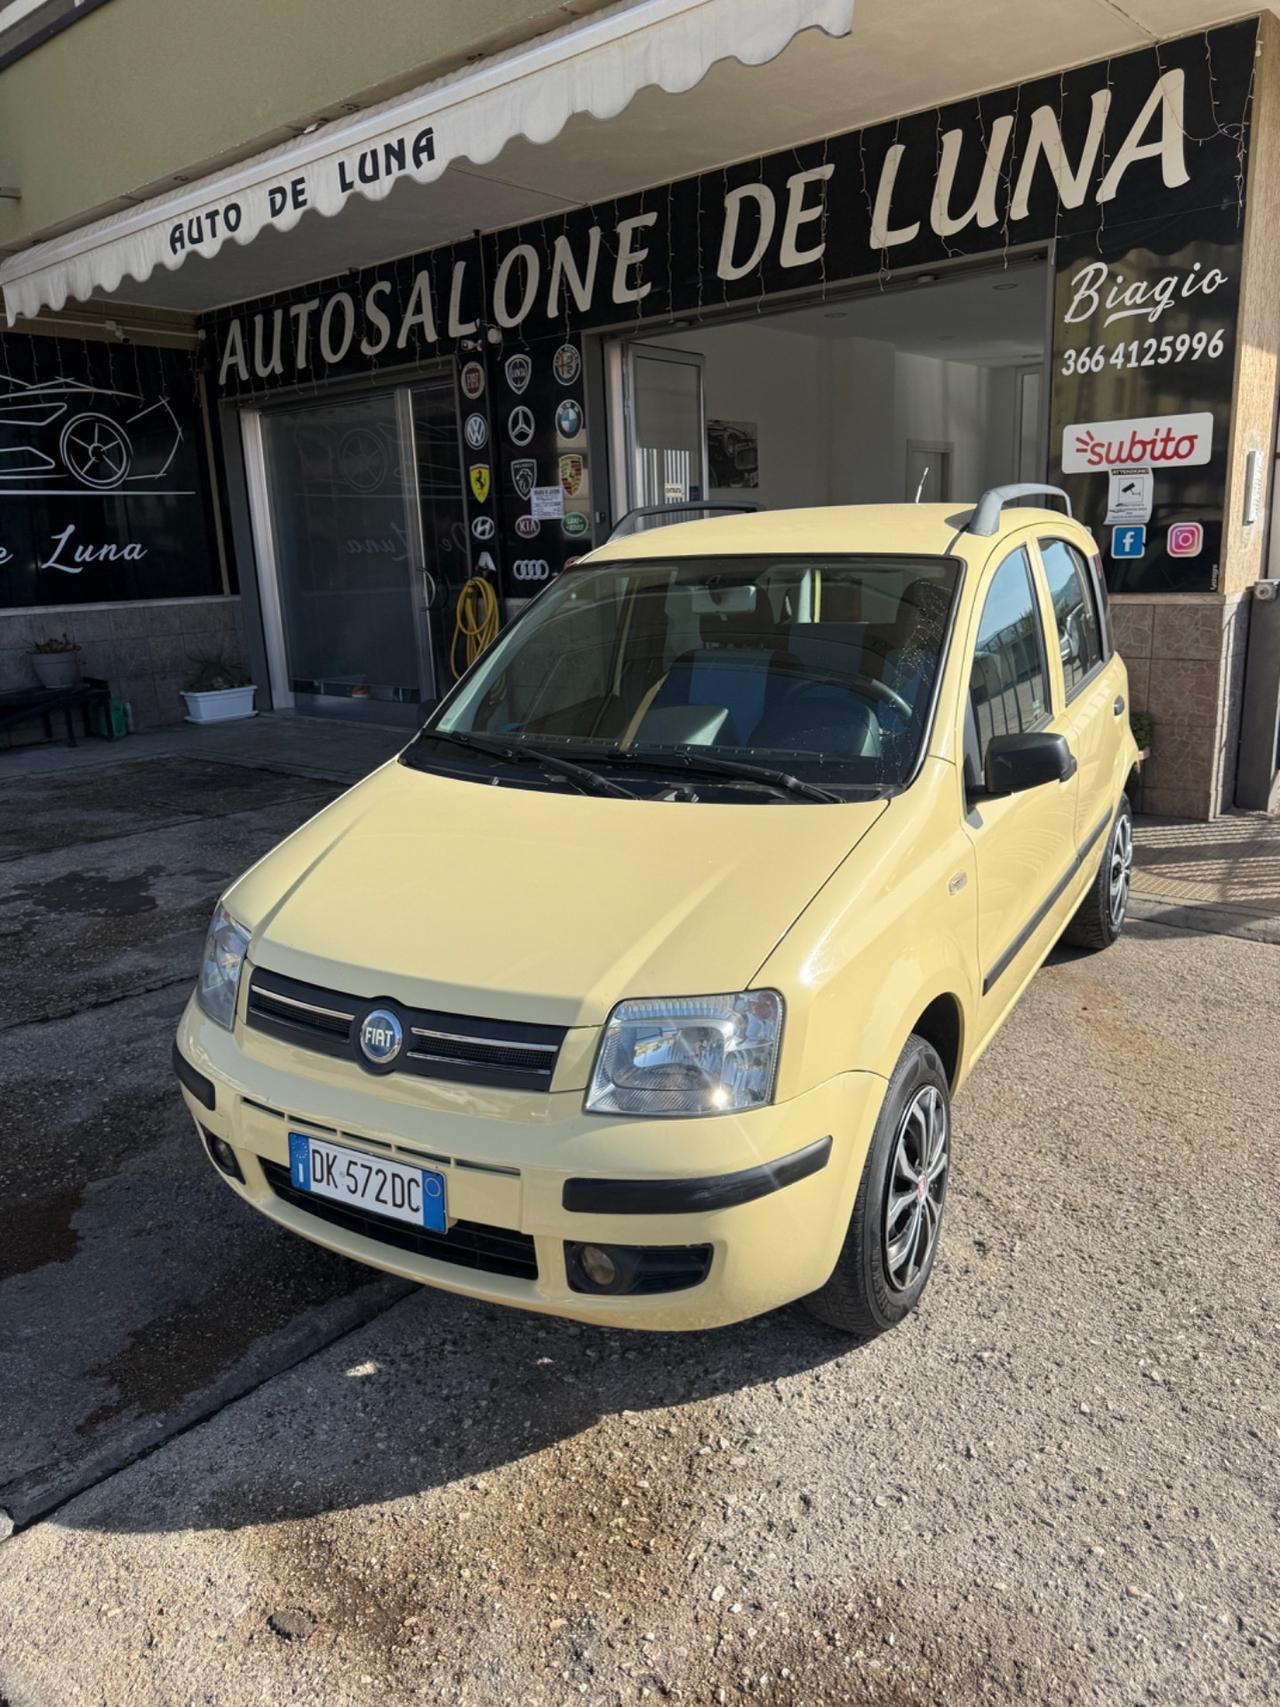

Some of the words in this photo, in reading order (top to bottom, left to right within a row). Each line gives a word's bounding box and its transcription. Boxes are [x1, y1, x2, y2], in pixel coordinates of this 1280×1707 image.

[169, 202, 242, 255] AUTO
[268, 176, 308, 218] DE
[337, 126, 436, 193] LUNA
[218, 211, 659, 386] AUTOSALONE
[716, 163, 835, 282] DE
[870, 68, 1192, 250] LUNA
[1064, 261, 1229, 328] Biagio
[1061, 344, 1106, 376] 366
[1109, 328, 1225, 370] 4125996
[1087, 427, 1199, 466] subito
[41, 524, 148, 574] Luna
[364, 1026, 394, 1048] FIAT
[311, 1148, 339, 1189] DK
[345, 1160, 421, 1213] 572DC
